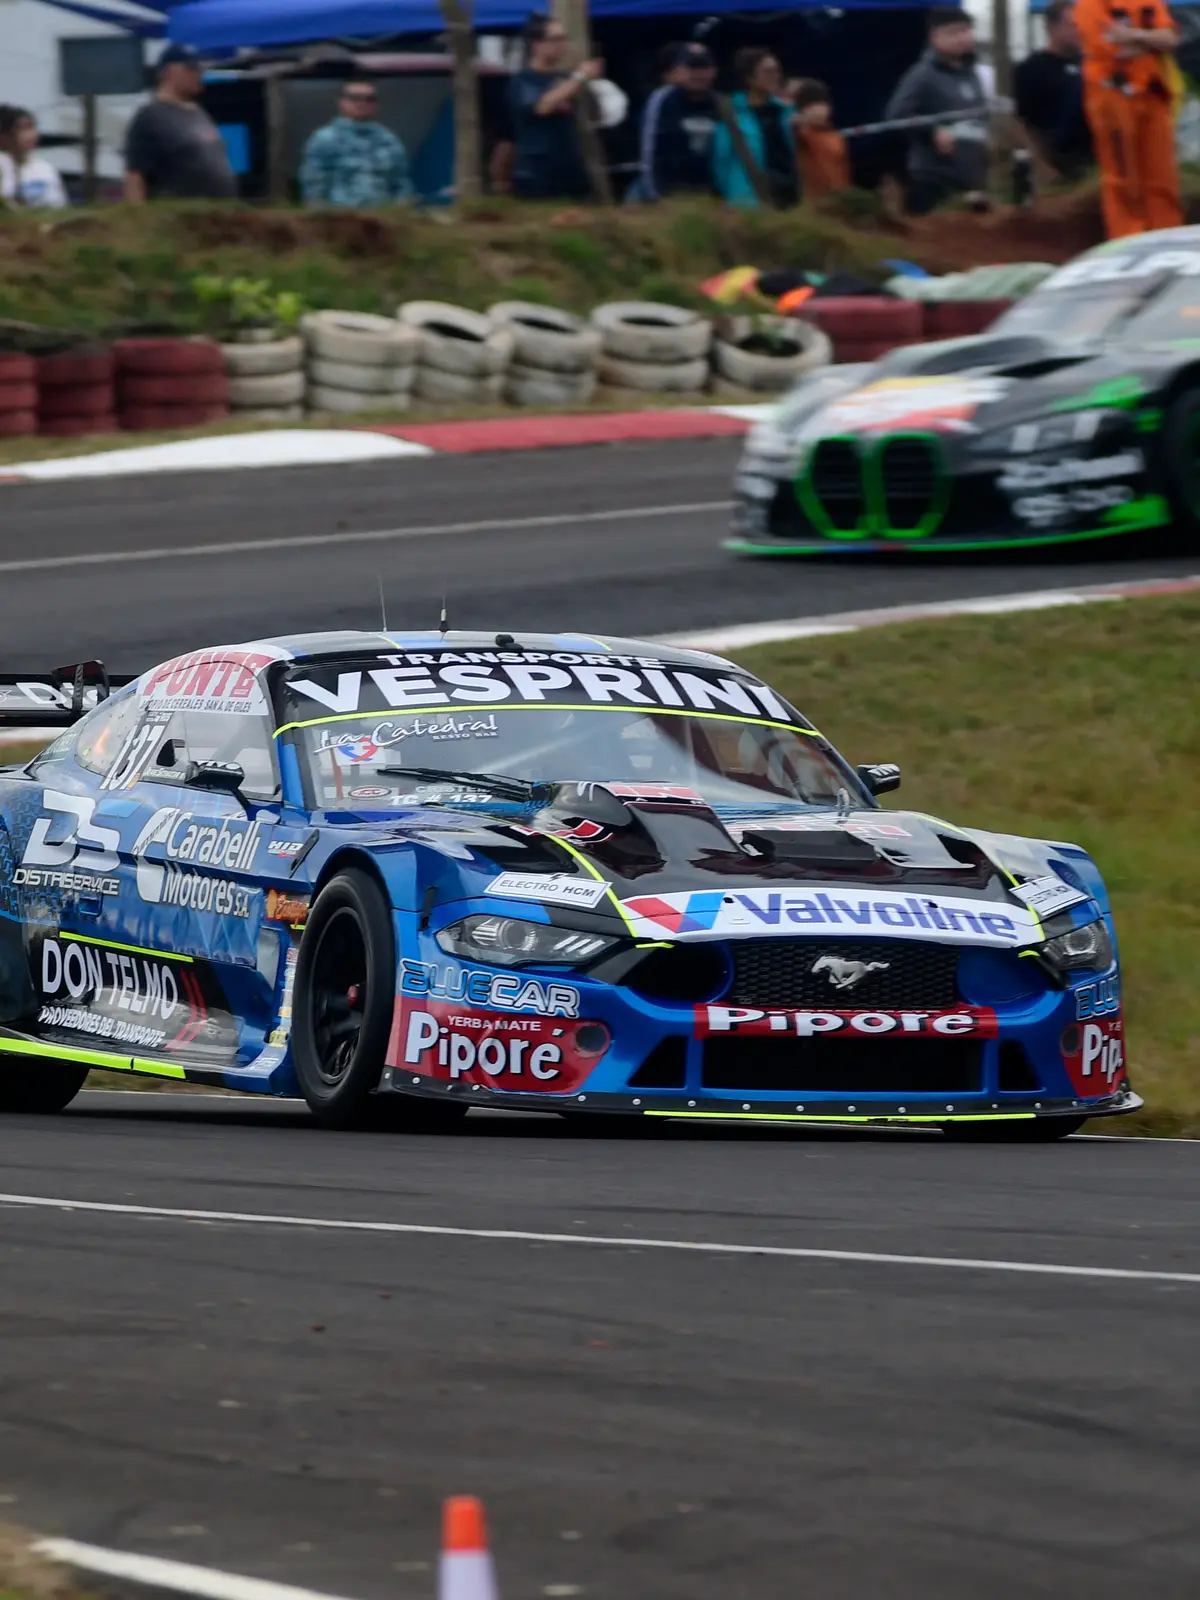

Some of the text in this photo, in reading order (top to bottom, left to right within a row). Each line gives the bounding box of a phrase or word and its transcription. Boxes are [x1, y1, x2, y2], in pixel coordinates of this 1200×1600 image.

[376, 652, 665, 669] TRANSPORTE
[285, 664, 791, 721] VESPRINI
[370, 714, 498, 747] Catedral
[450, 794, 492, 803] 137
[166, 811, 261, 870] Carabelli
[162, 863, 236, 915] Motores
[500, 879, 596, 898] ELECTRO HCM
[739, 892, 1018, 940] Valvoline
[42, 939, 178, 1020] DON TELMO
[400, 958, 579, 1018] BLUECAR
[38, 1005, 166, 1047] PROVEEDORES DEL TRANSPORTE
[707, 1005, 975, 1036] Piporé
[404, 1010, 563, 1080] Piporé
